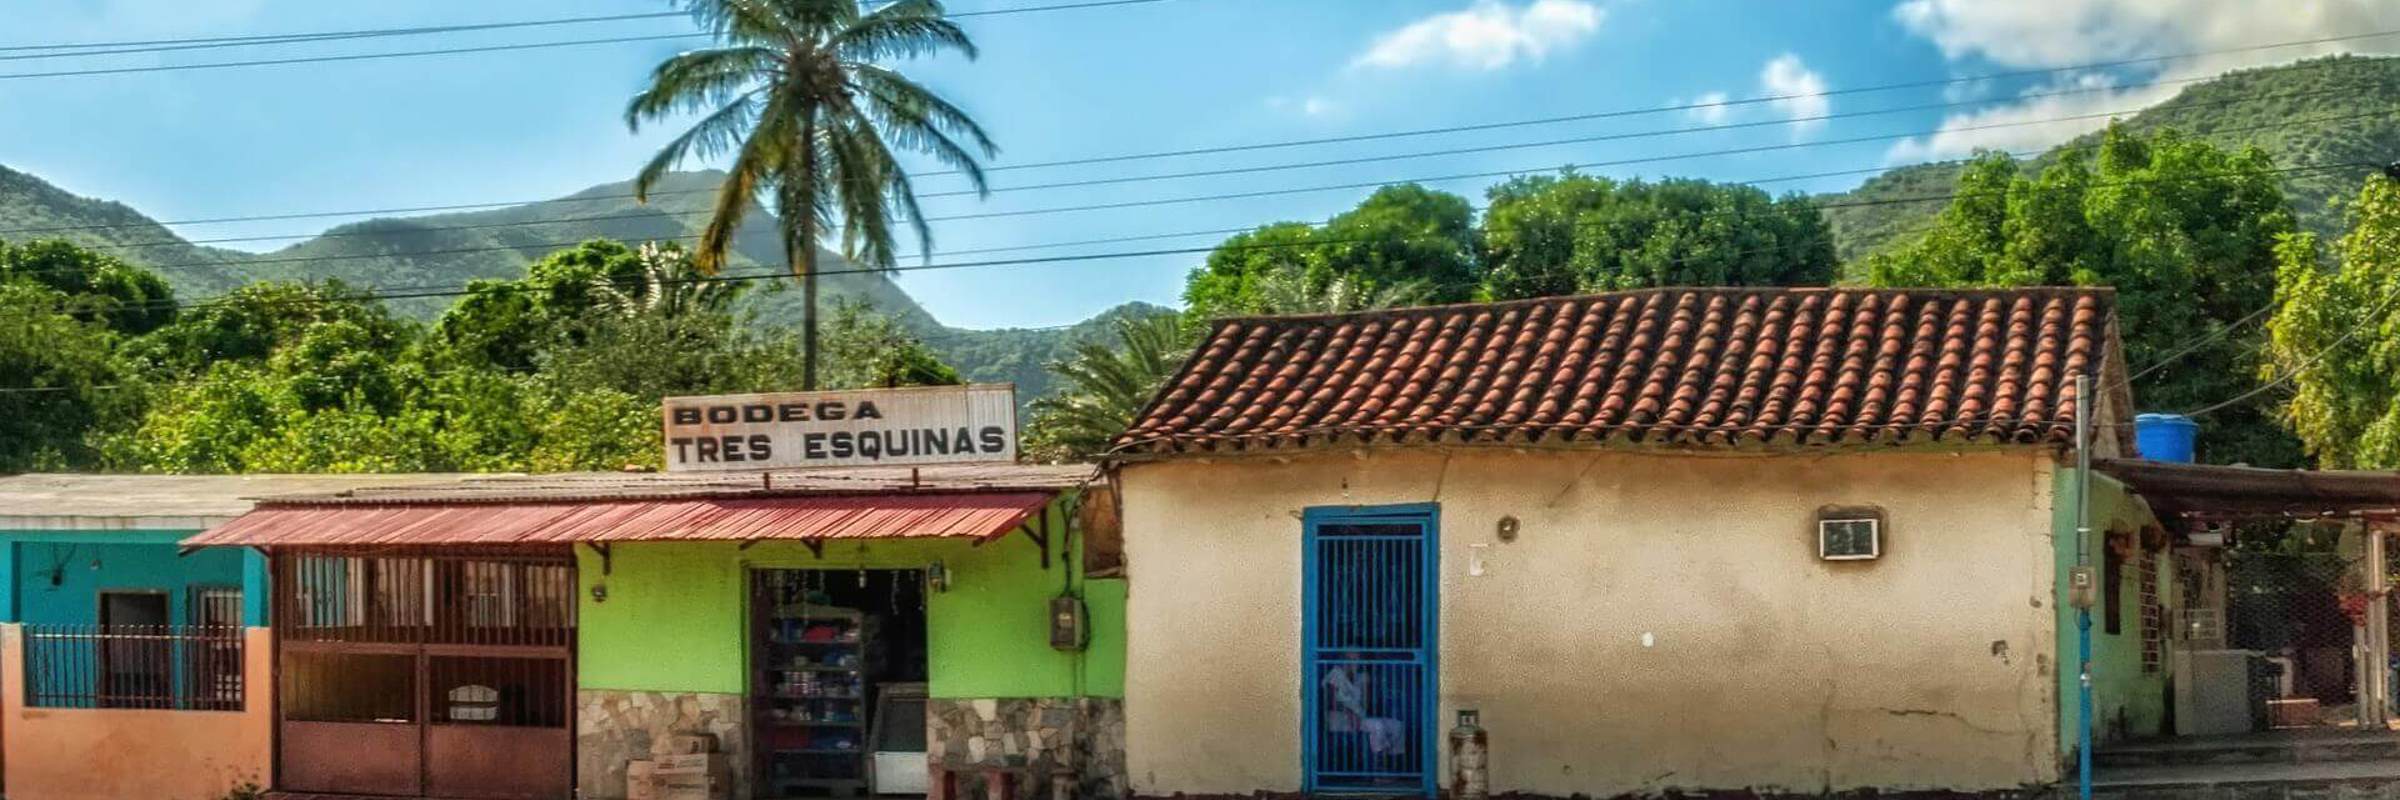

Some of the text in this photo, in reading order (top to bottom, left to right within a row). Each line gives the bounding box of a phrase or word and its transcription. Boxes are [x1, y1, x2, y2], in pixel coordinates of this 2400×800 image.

[672, 402, 882, 425] BODEGA
[671, 427, 1005, 463] TRES ESQUINAS
